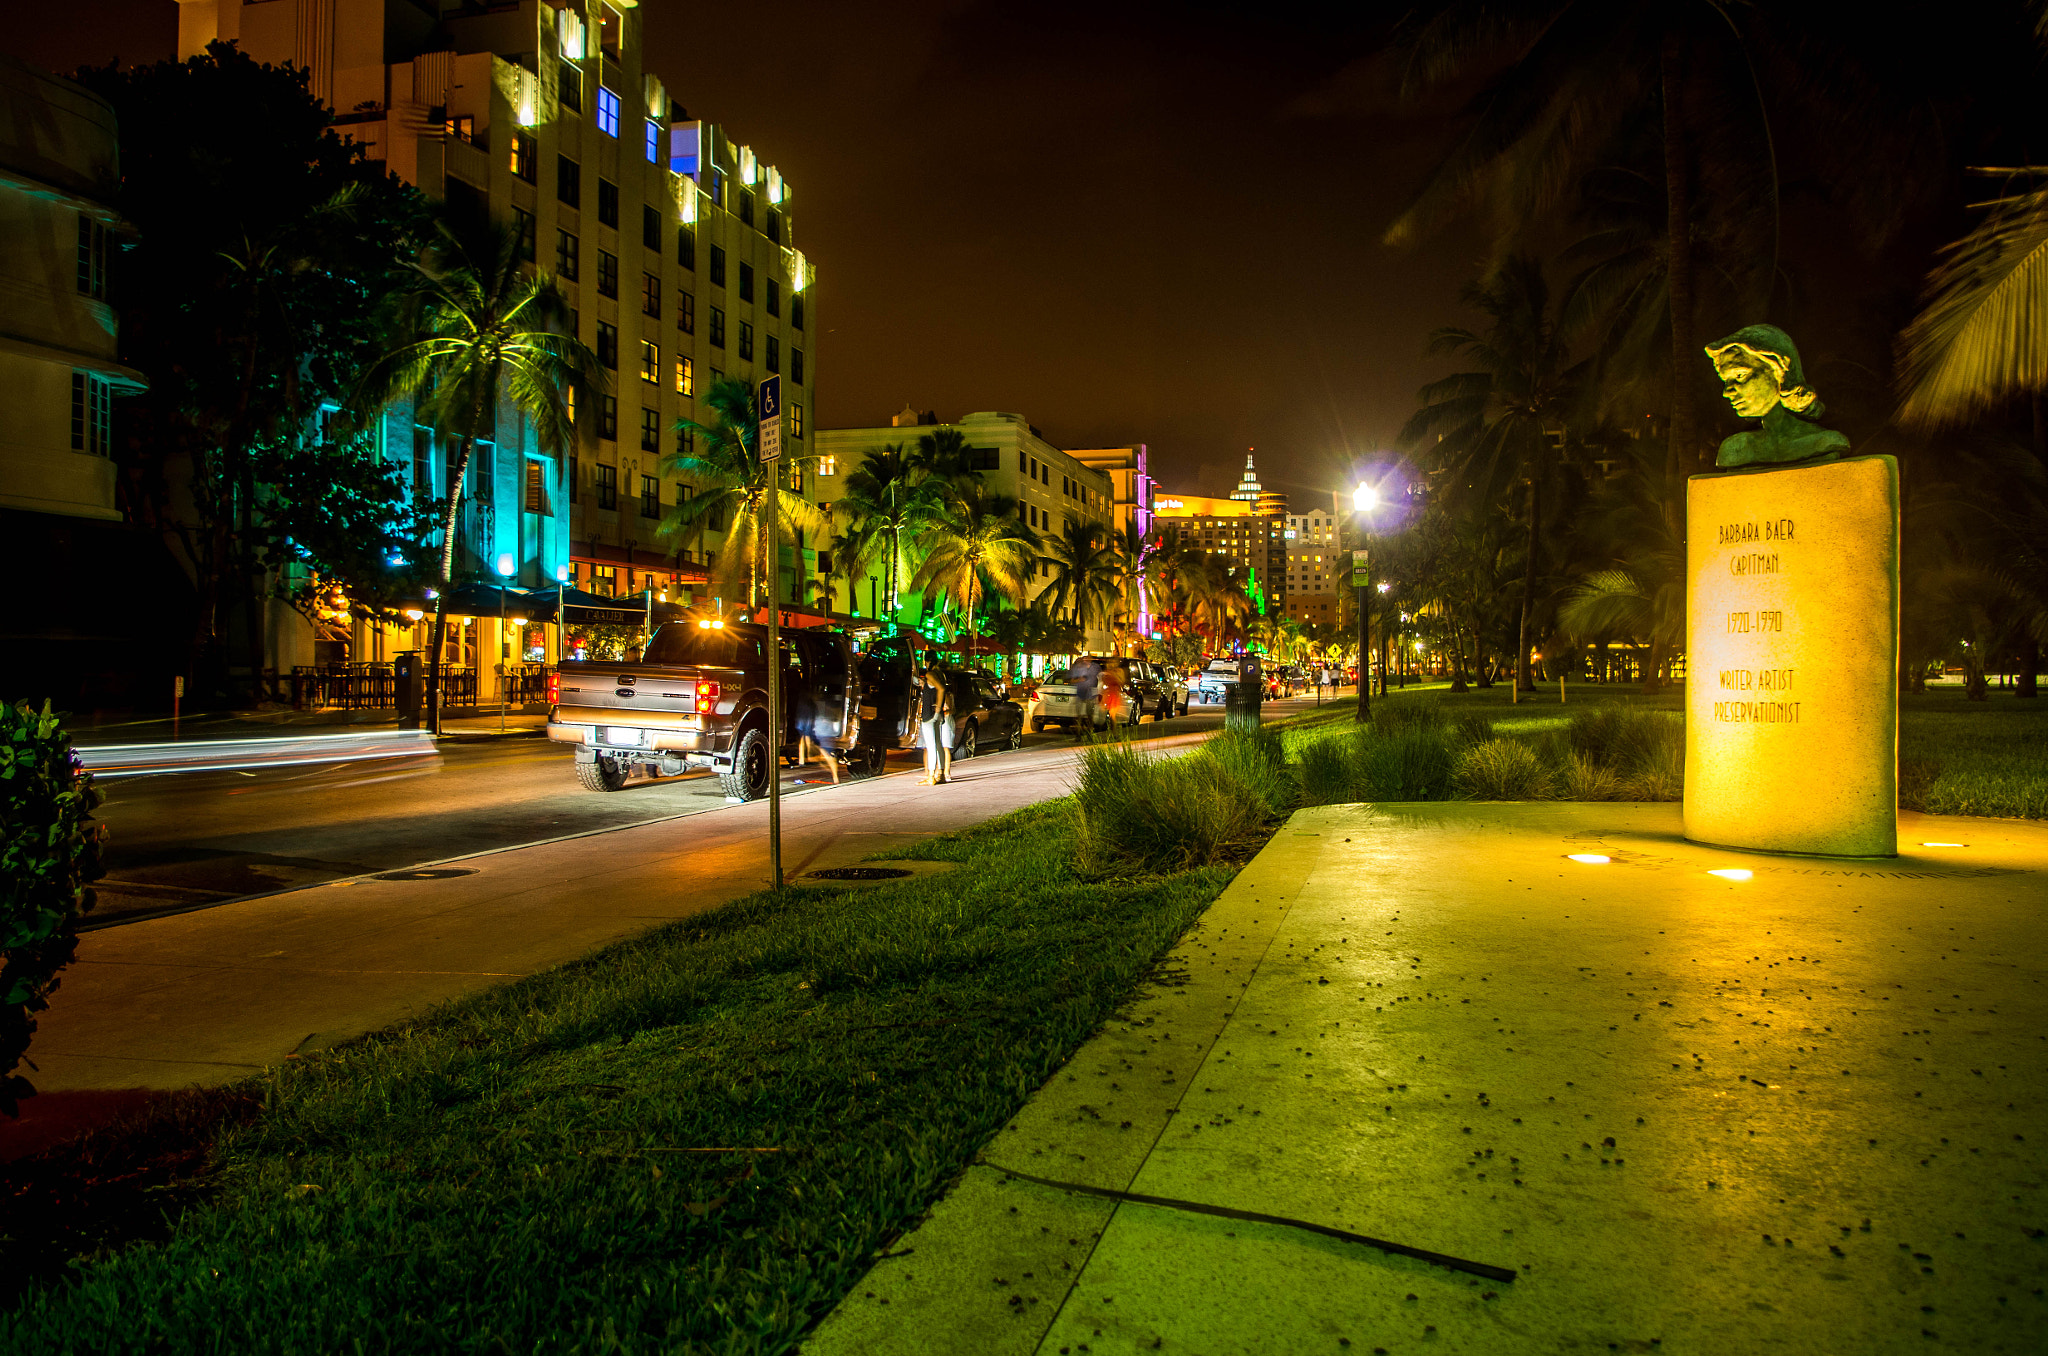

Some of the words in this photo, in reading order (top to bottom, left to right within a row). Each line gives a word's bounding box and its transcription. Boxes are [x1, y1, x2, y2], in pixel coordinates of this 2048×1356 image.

[1719, 523, 1760, 545] BARBARA
[1766, 519, 1795, 542] BAER
[1730, 553, 1779, 576] CAPITMAN
[585, 609, 625, 622] CAVALIER
[1727, 611, 1782, 634] 1920-1990
[1719, 670, 1752, 691] WRITER
[1758, 669, 1794, 691] ARTIST
[1714, 702, 1801, 724] PRESERVATIONIST
